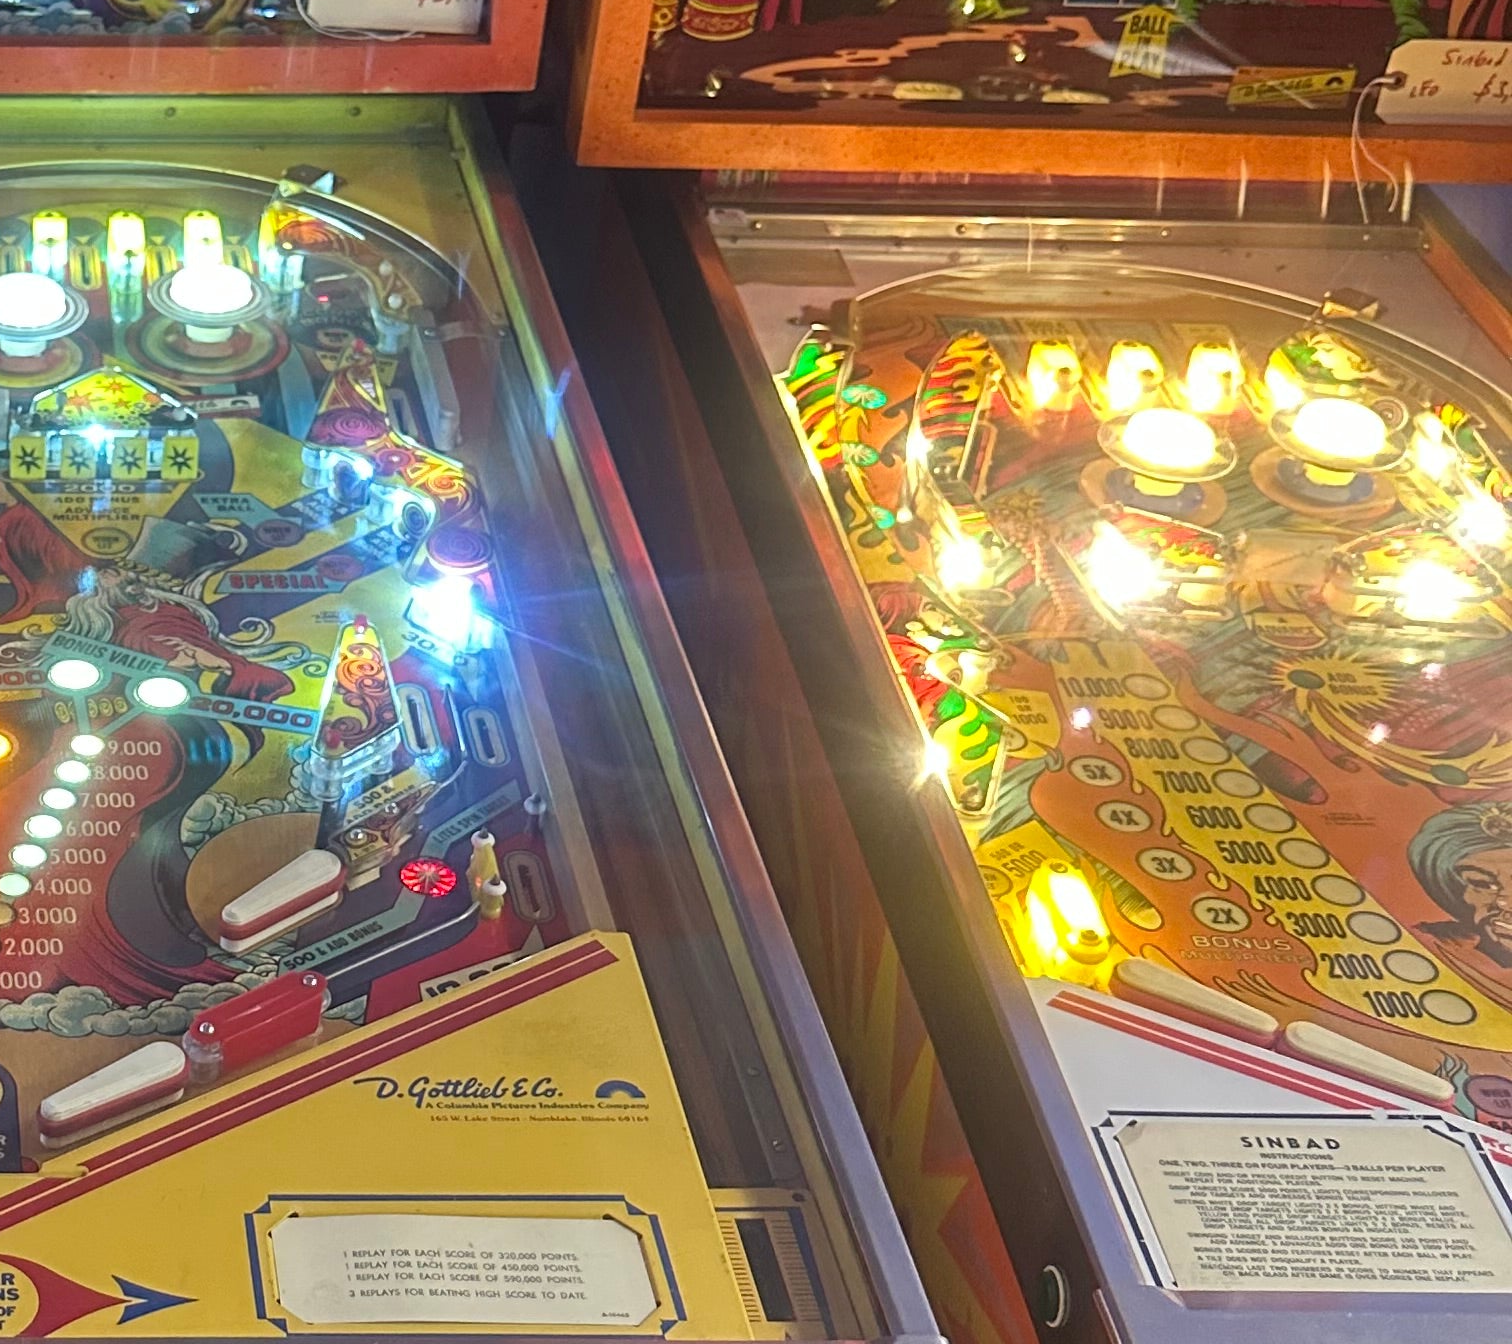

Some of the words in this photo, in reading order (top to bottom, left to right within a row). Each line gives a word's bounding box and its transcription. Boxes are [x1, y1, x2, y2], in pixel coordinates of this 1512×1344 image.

[1129, 14, 1167, 36] BALL
[64, 483, 136, 494] 2000
[228, 573, 329, 590] SPECIAL
[50, 634, 110, 658] BONUS
[108, 651, 165, 674] VALUE
[1098, 709, 1154, 731] 9000
[1123, 737, 1178, 759] 8000
[1082, 763, 1113, 782] 5X
[1153, 770, 1211, 794] 7000
[1109, 808, 1139, 827] 4X
[1186, 805, 1243, 829] 6000
[1215, 839, 1276, 865] 5000
[1151, 855, 1183, 874] 3X
[1253, 876, 1313, 902] 4000
[1206, 907, 1238, 926] 2X
[1286, 911, 1347, 939] 3000
[3, 937, 64, 956] 2,000
[283, 951, 316, 970] 500
[348, 921, 384, 942] BONUS
[1191, 934, 1293, 951] BONUS
[1320, 953, 1384, 980] 2000
[1362, 990, 1424, 1018] 1000
[407, 1076, 509, 1109] Gottlieb
[530, 1077, 564, 1098] Co.
[597, 1102, 650, 1111] Company
[1239, 1135, 1341, 1150] SINBAD
[352, 1249, 386, 1257] REPLAY
[414, 1249, 441, 1257] EACH
[445, 1250, 476, 1258] SCORE
[360, 1288, 401, 1297] REPLAYS
[404, 1288, 424, 1296] FOR
[429, 1288, 471, 1297] BEATING
[475, 1289, 501, 1298] HIGH
[505, 1290, 537, 1299] SCORE
